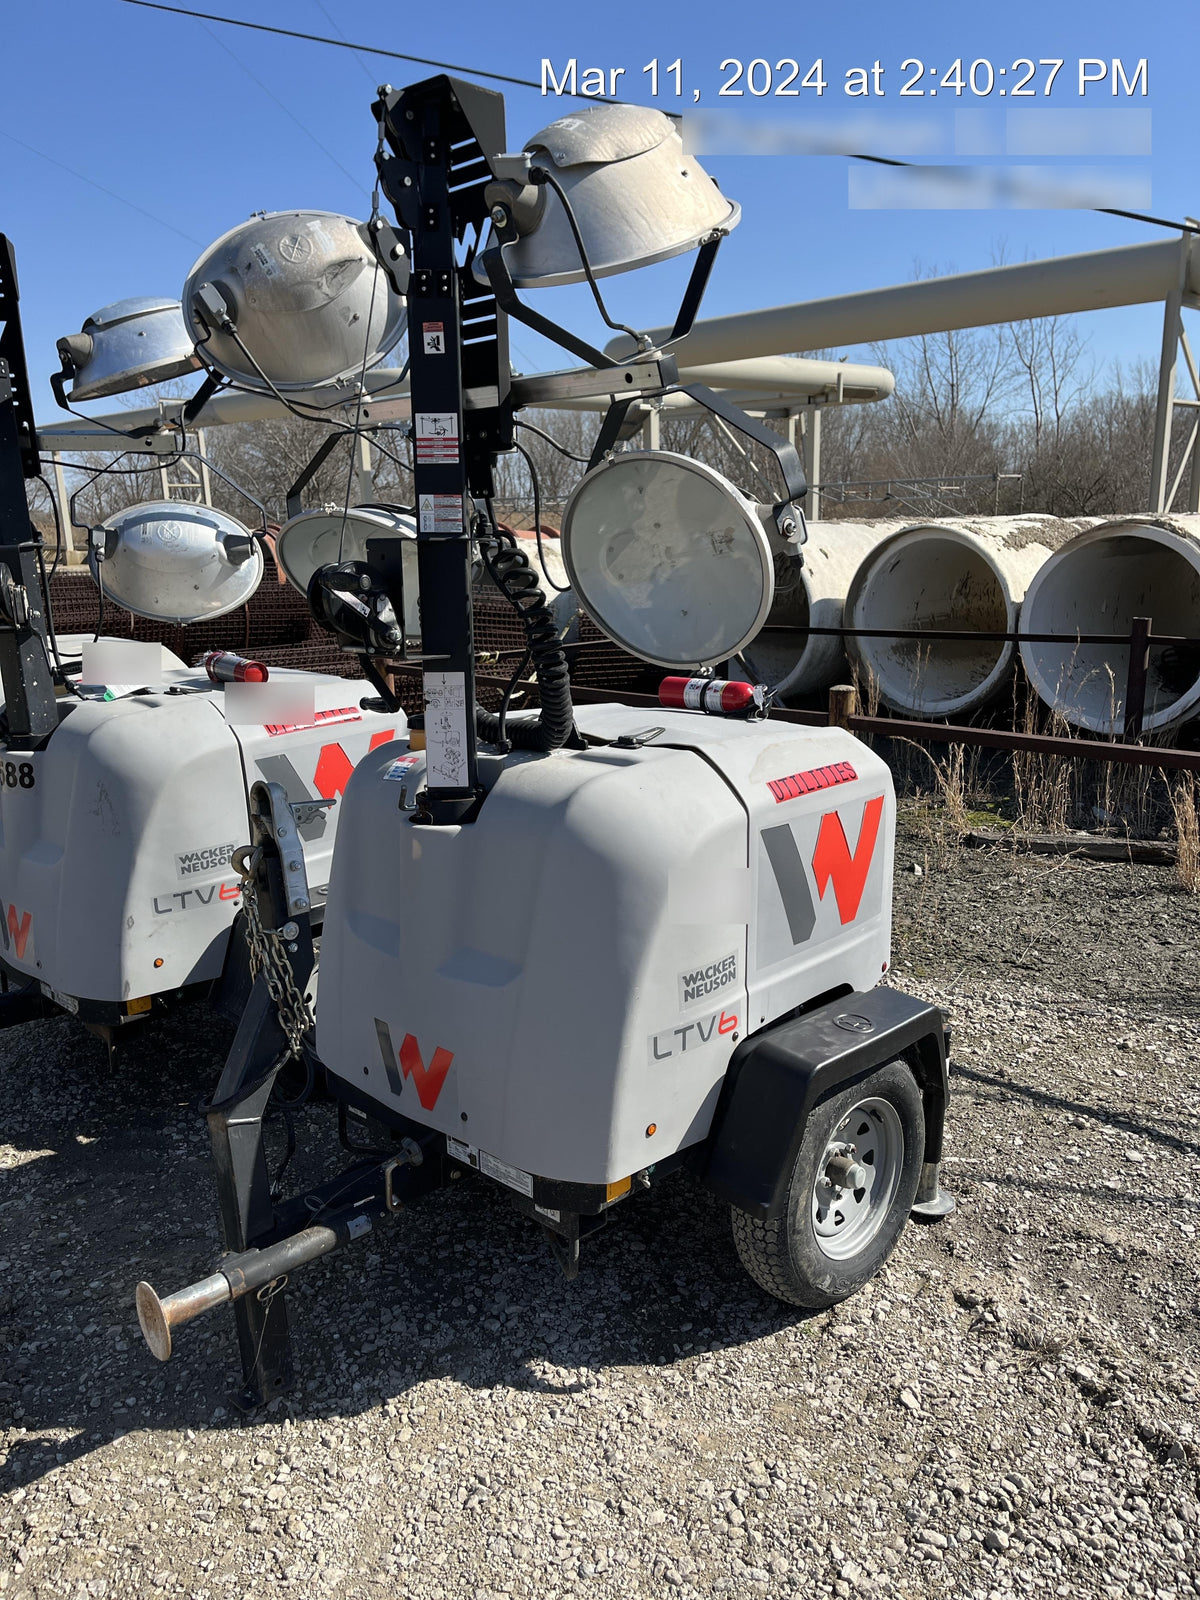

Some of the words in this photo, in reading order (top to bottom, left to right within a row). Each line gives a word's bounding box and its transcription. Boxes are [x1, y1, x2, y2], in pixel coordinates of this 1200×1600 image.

[768, 761, 857, 801] UTILITIES
[179, 844, 235, 864] WACKER
[153, 883, 240, 914] LTV6
[682, 955, 736, 988] WACKER
[684, 967, 736, 1002] NEUSON
[653, 1011, 738, 1060] LTV6
